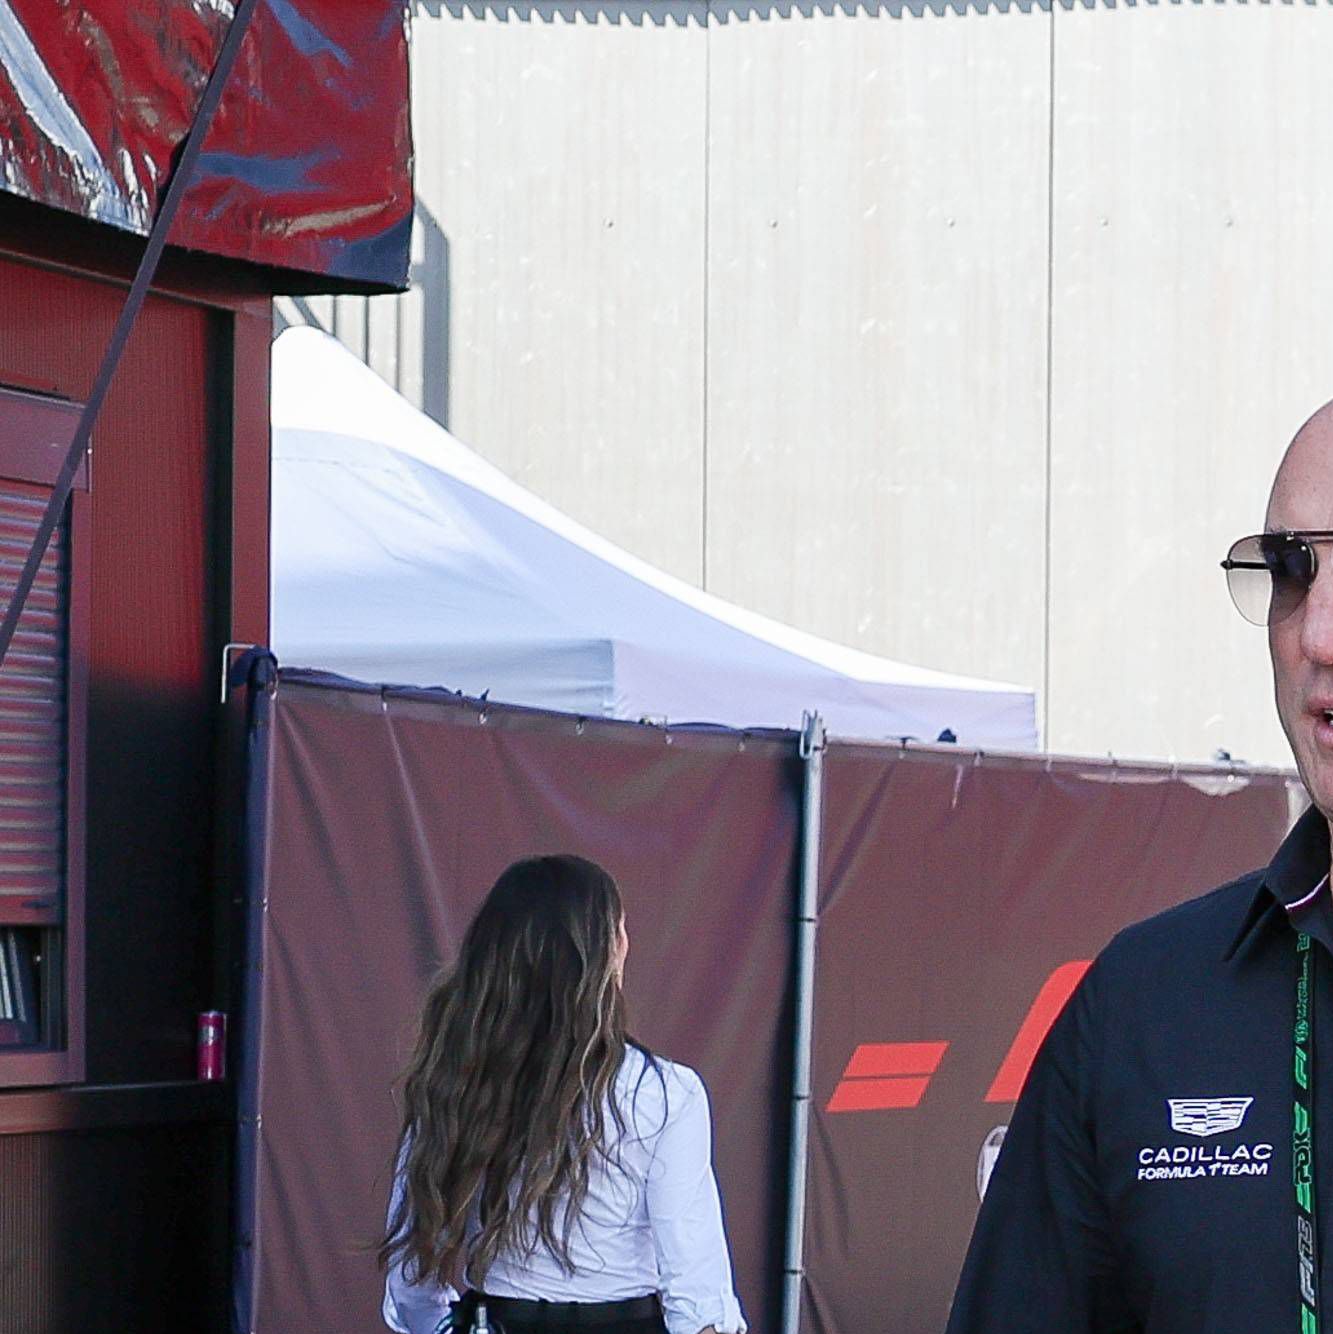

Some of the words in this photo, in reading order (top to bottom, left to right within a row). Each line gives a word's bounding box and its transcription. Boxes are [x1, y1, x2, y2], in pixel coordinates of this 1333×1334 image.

[1138, 1144, 1273, 1164] CADILLAC
[1138, 1166, 1206, 1180] FORMULA
[1222, 1162, 1268, 1176] TEAM
